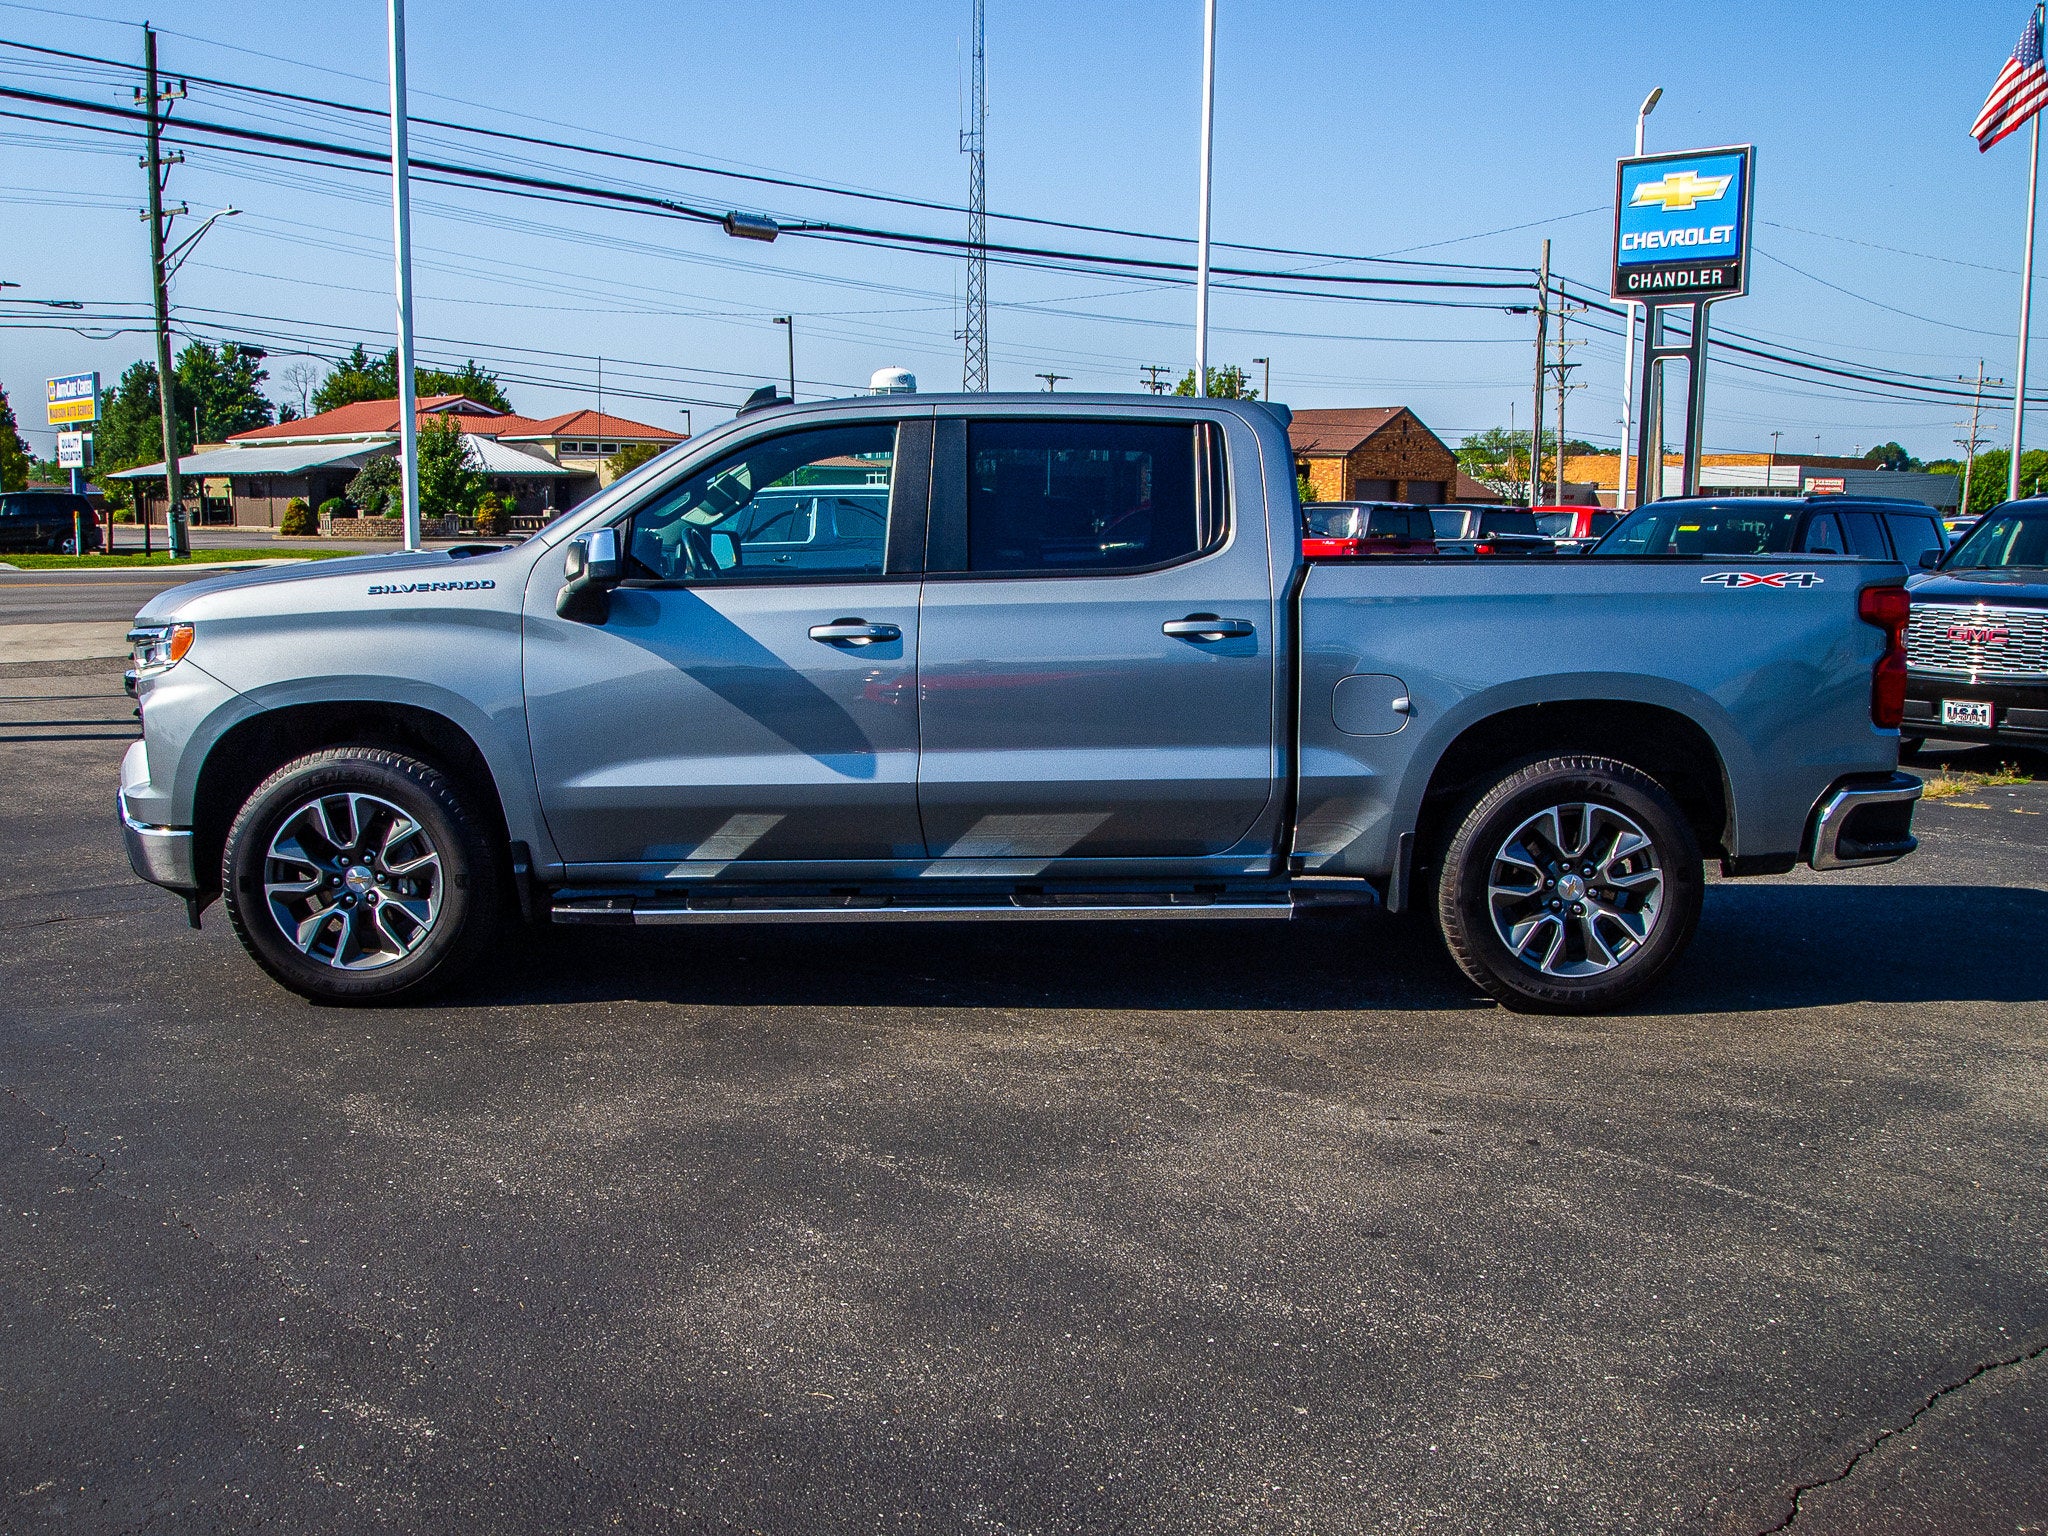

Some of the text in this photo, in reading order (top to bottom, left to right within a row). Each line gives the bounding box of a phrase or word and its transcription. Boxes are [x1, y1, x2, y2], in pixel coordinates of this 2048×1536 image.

[1621, 225, 1734, 251] CHEVROLET
[1628, 269, 1723, 290] CHANDLER
[367, 580, 497, 595] SILVERADO
[1947, 626, 2010, 643] GMC
